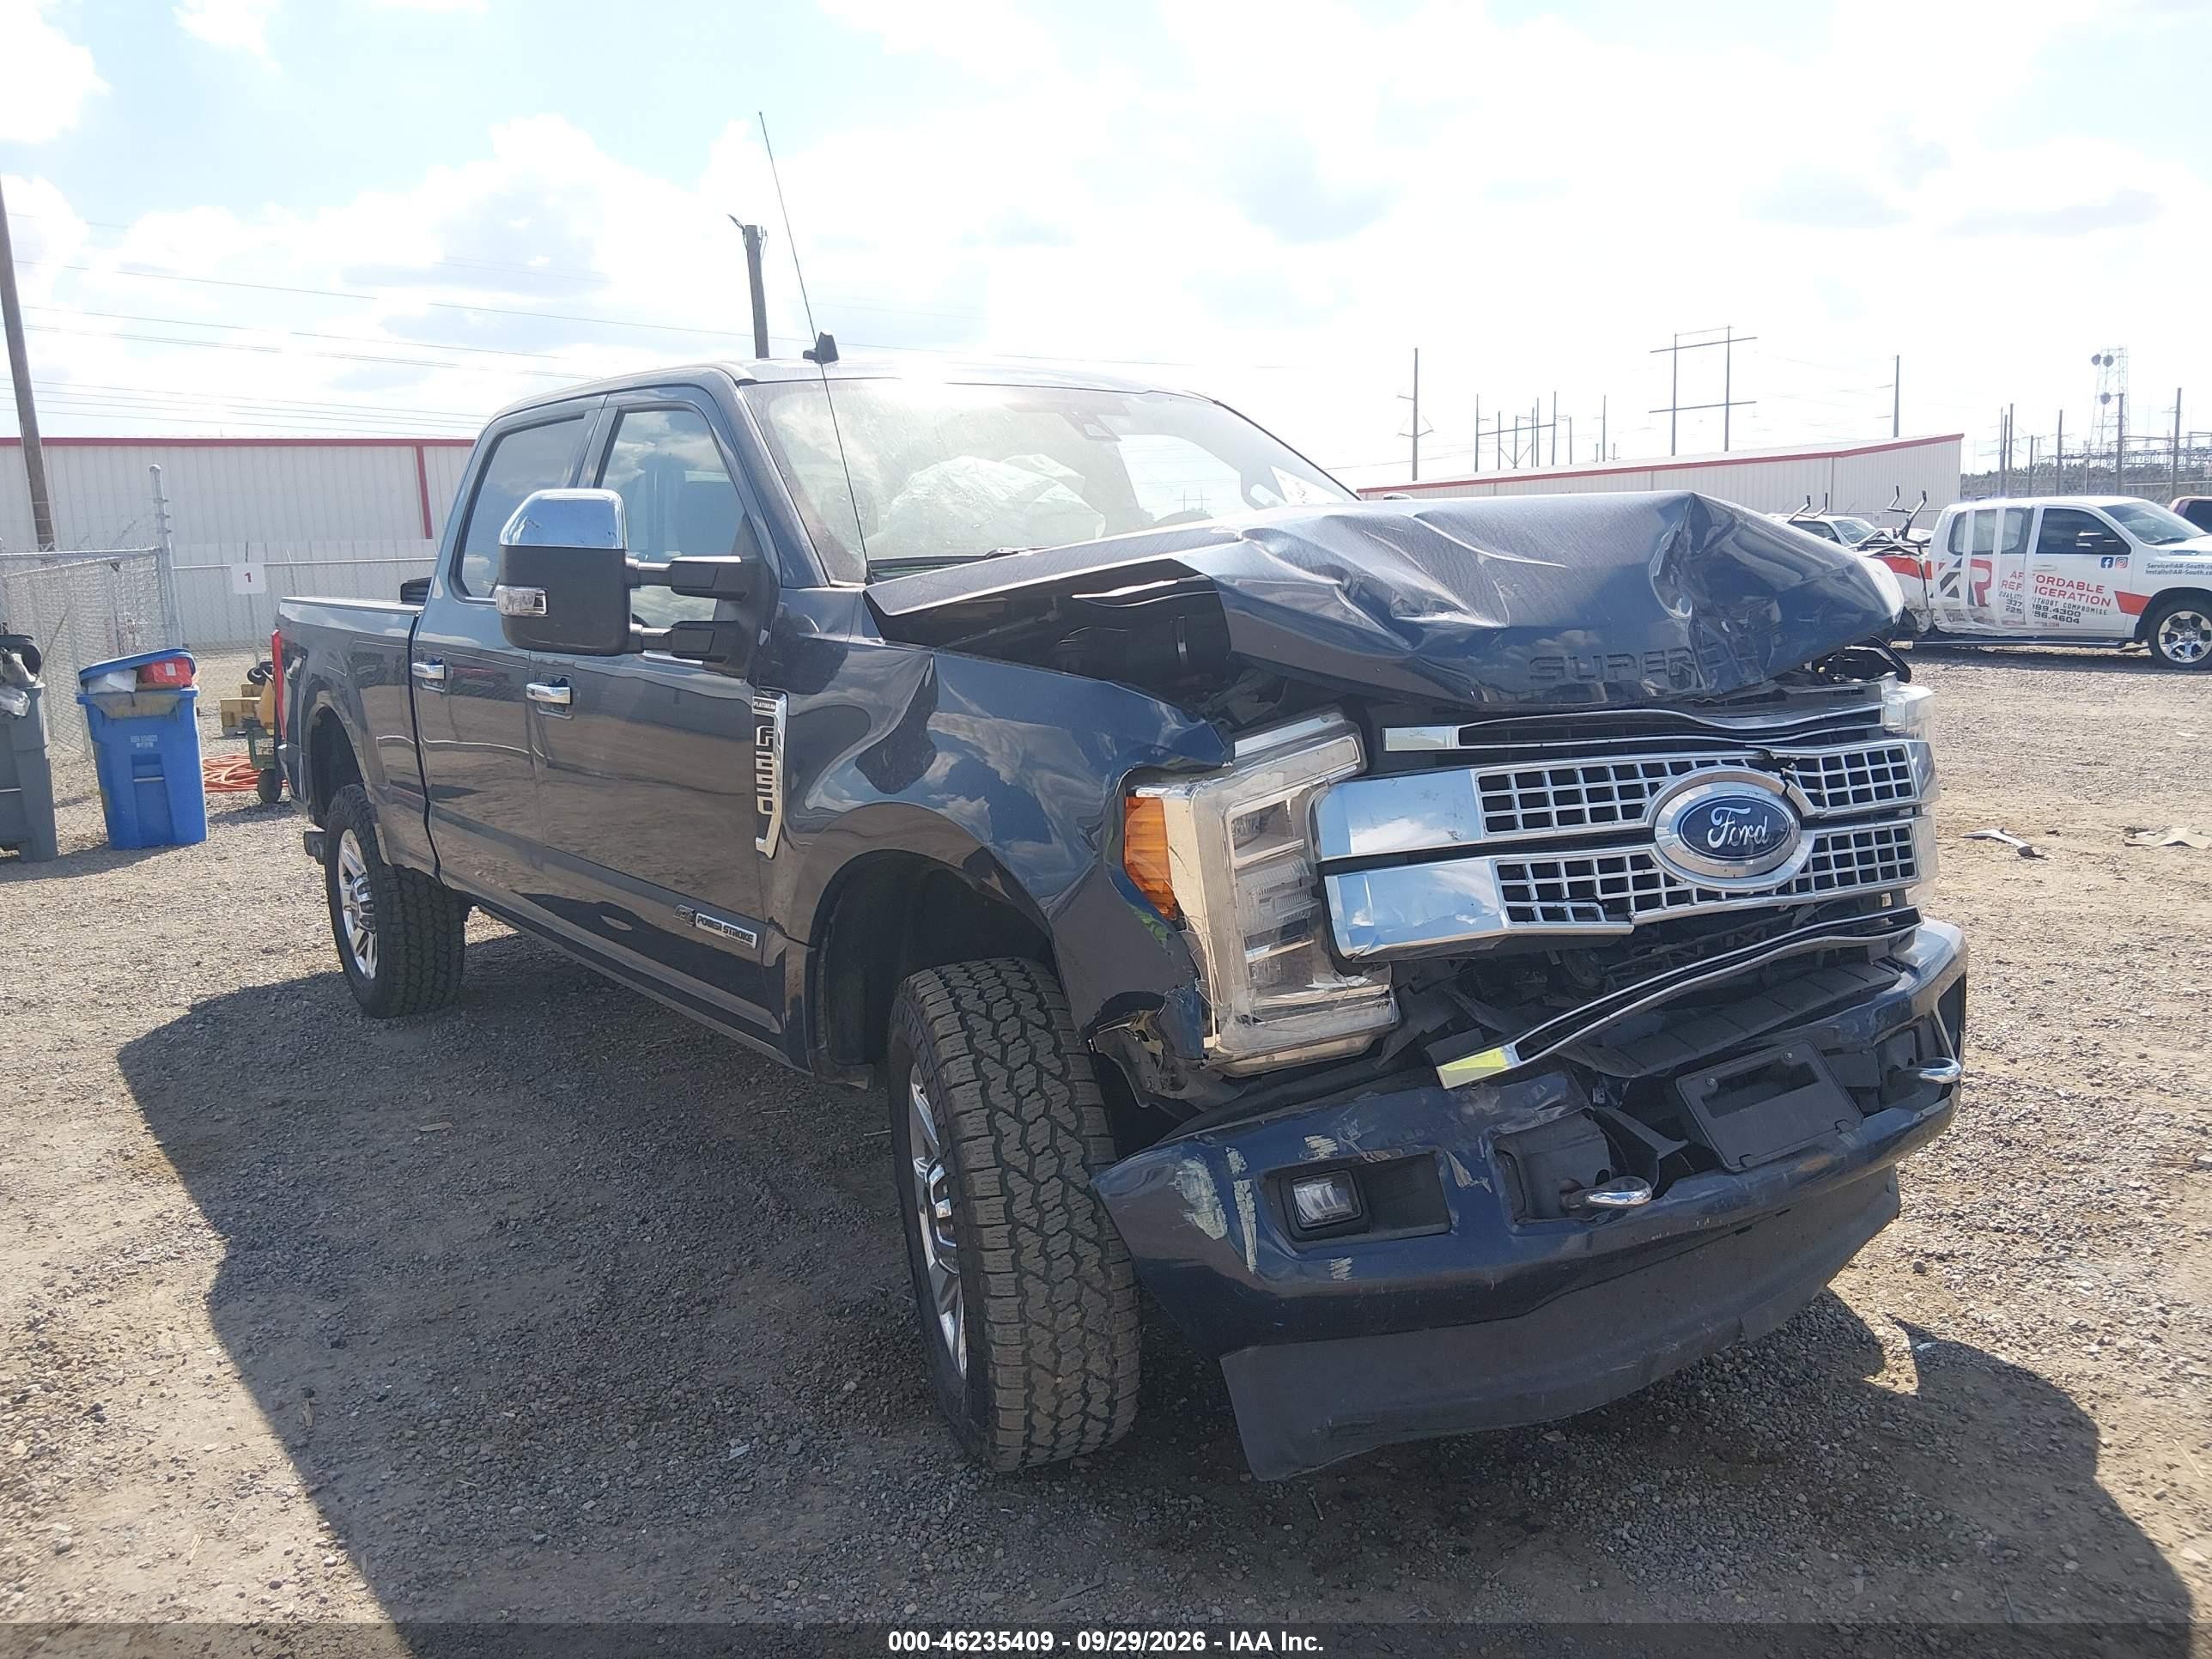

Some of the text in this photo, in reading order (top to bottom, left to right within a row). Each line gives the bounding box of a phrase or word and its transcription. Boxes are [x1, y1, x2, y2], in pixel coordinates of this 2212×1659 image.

[244, 572, 252, 583] 1
[2009, 570, 2106, 594] AFORDABLE
[2001, 580, 2112, 606] REFIGERATION
[2032, 597, 2059, 607] ITHOUT
[1528, 646, 1695, 682] SUPER
[1707, 807, 1769, 848] Ford
